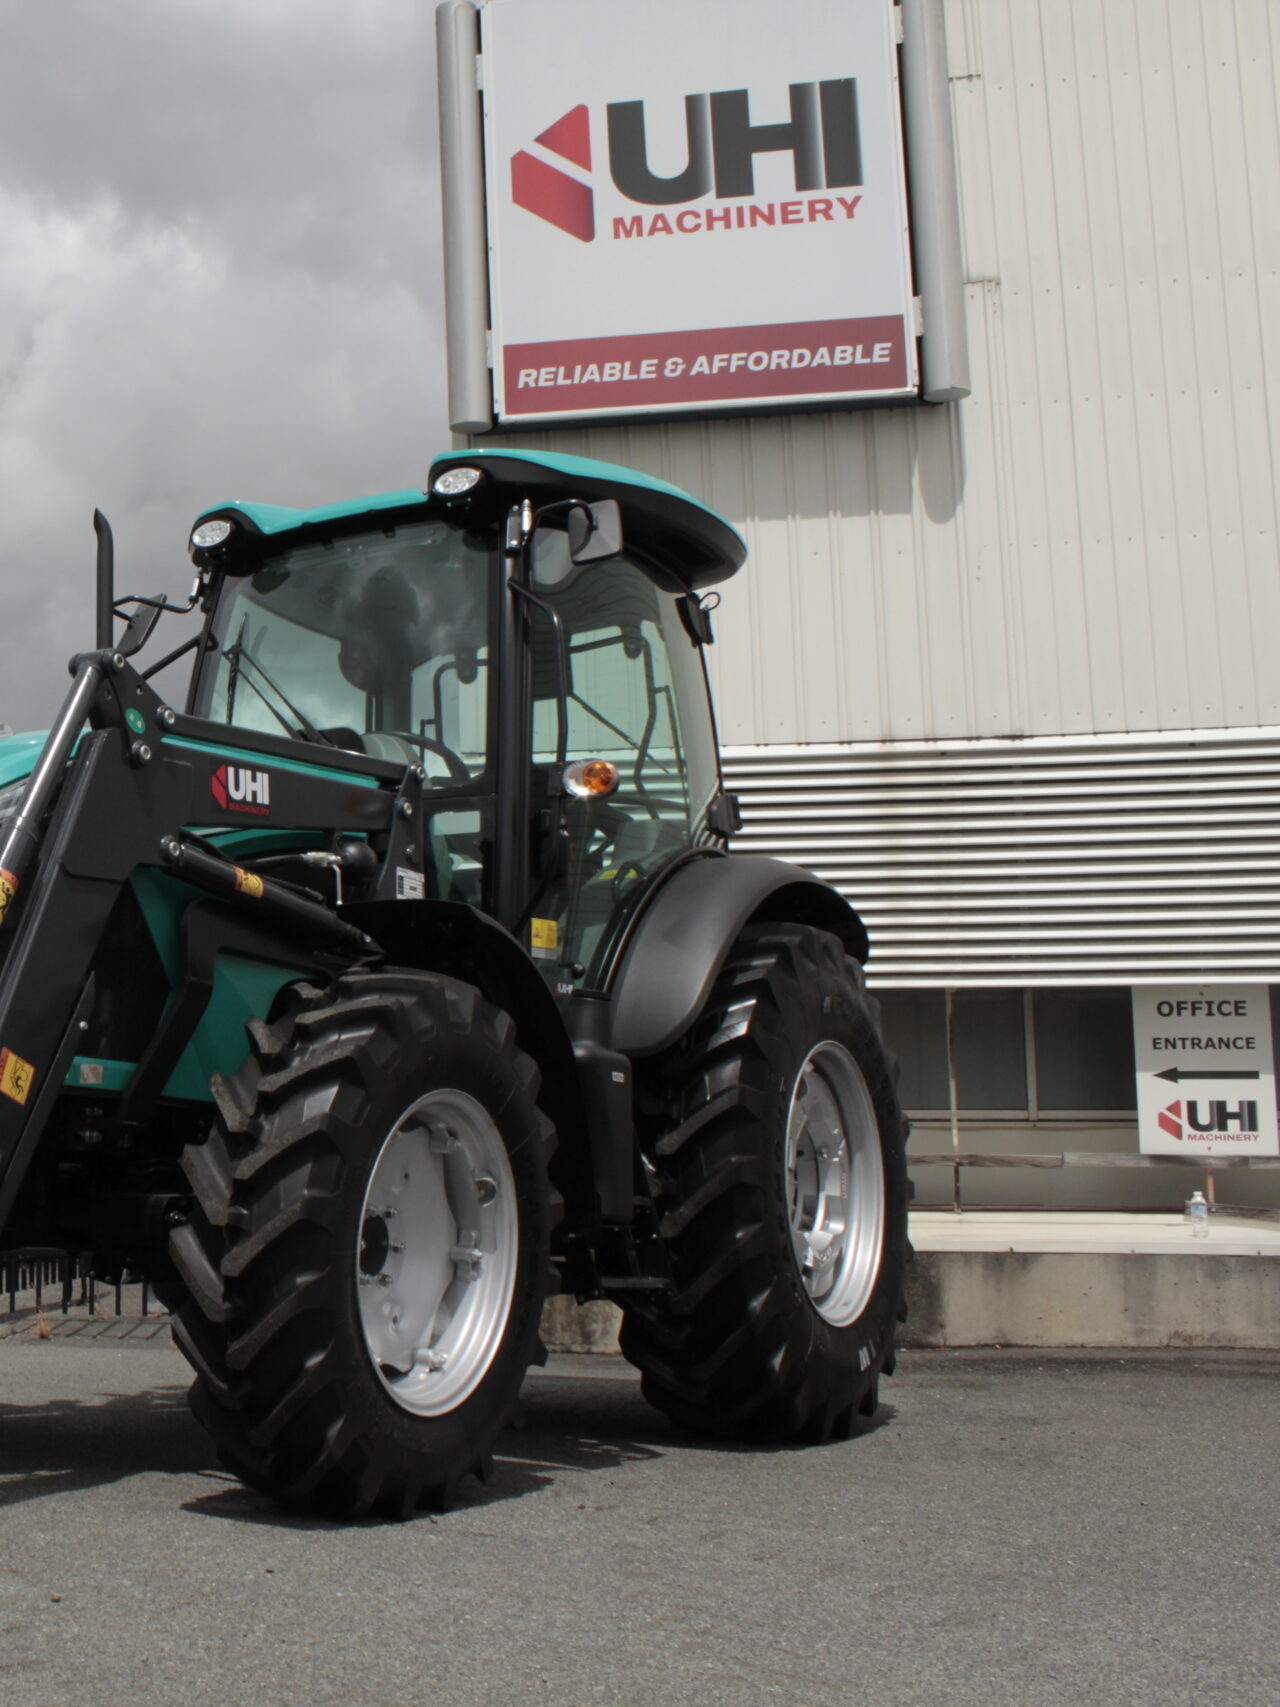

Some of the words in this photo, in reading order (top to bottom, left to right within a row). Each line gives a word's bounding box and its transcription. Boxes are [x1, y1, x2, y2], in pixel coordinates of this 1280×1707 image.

[606, 77, 864, 206] UHI
[613, 195, 863, 240] MACHINERY
[517, 358, 659, 389] RELIABLE
[663, 357, 687, 378] &
[690, 342, 893, 376] AFFORDABLE
[227, 766, 270, 805] UHI
[1156, 1000, 1248, 1017] OFFICE
[1152, 1037, 1256, 1050] ENTRANCE
[1186, 1100, 1259, 1132] UHI
[1187, 1134, 1260, 1142] MACHINERY
